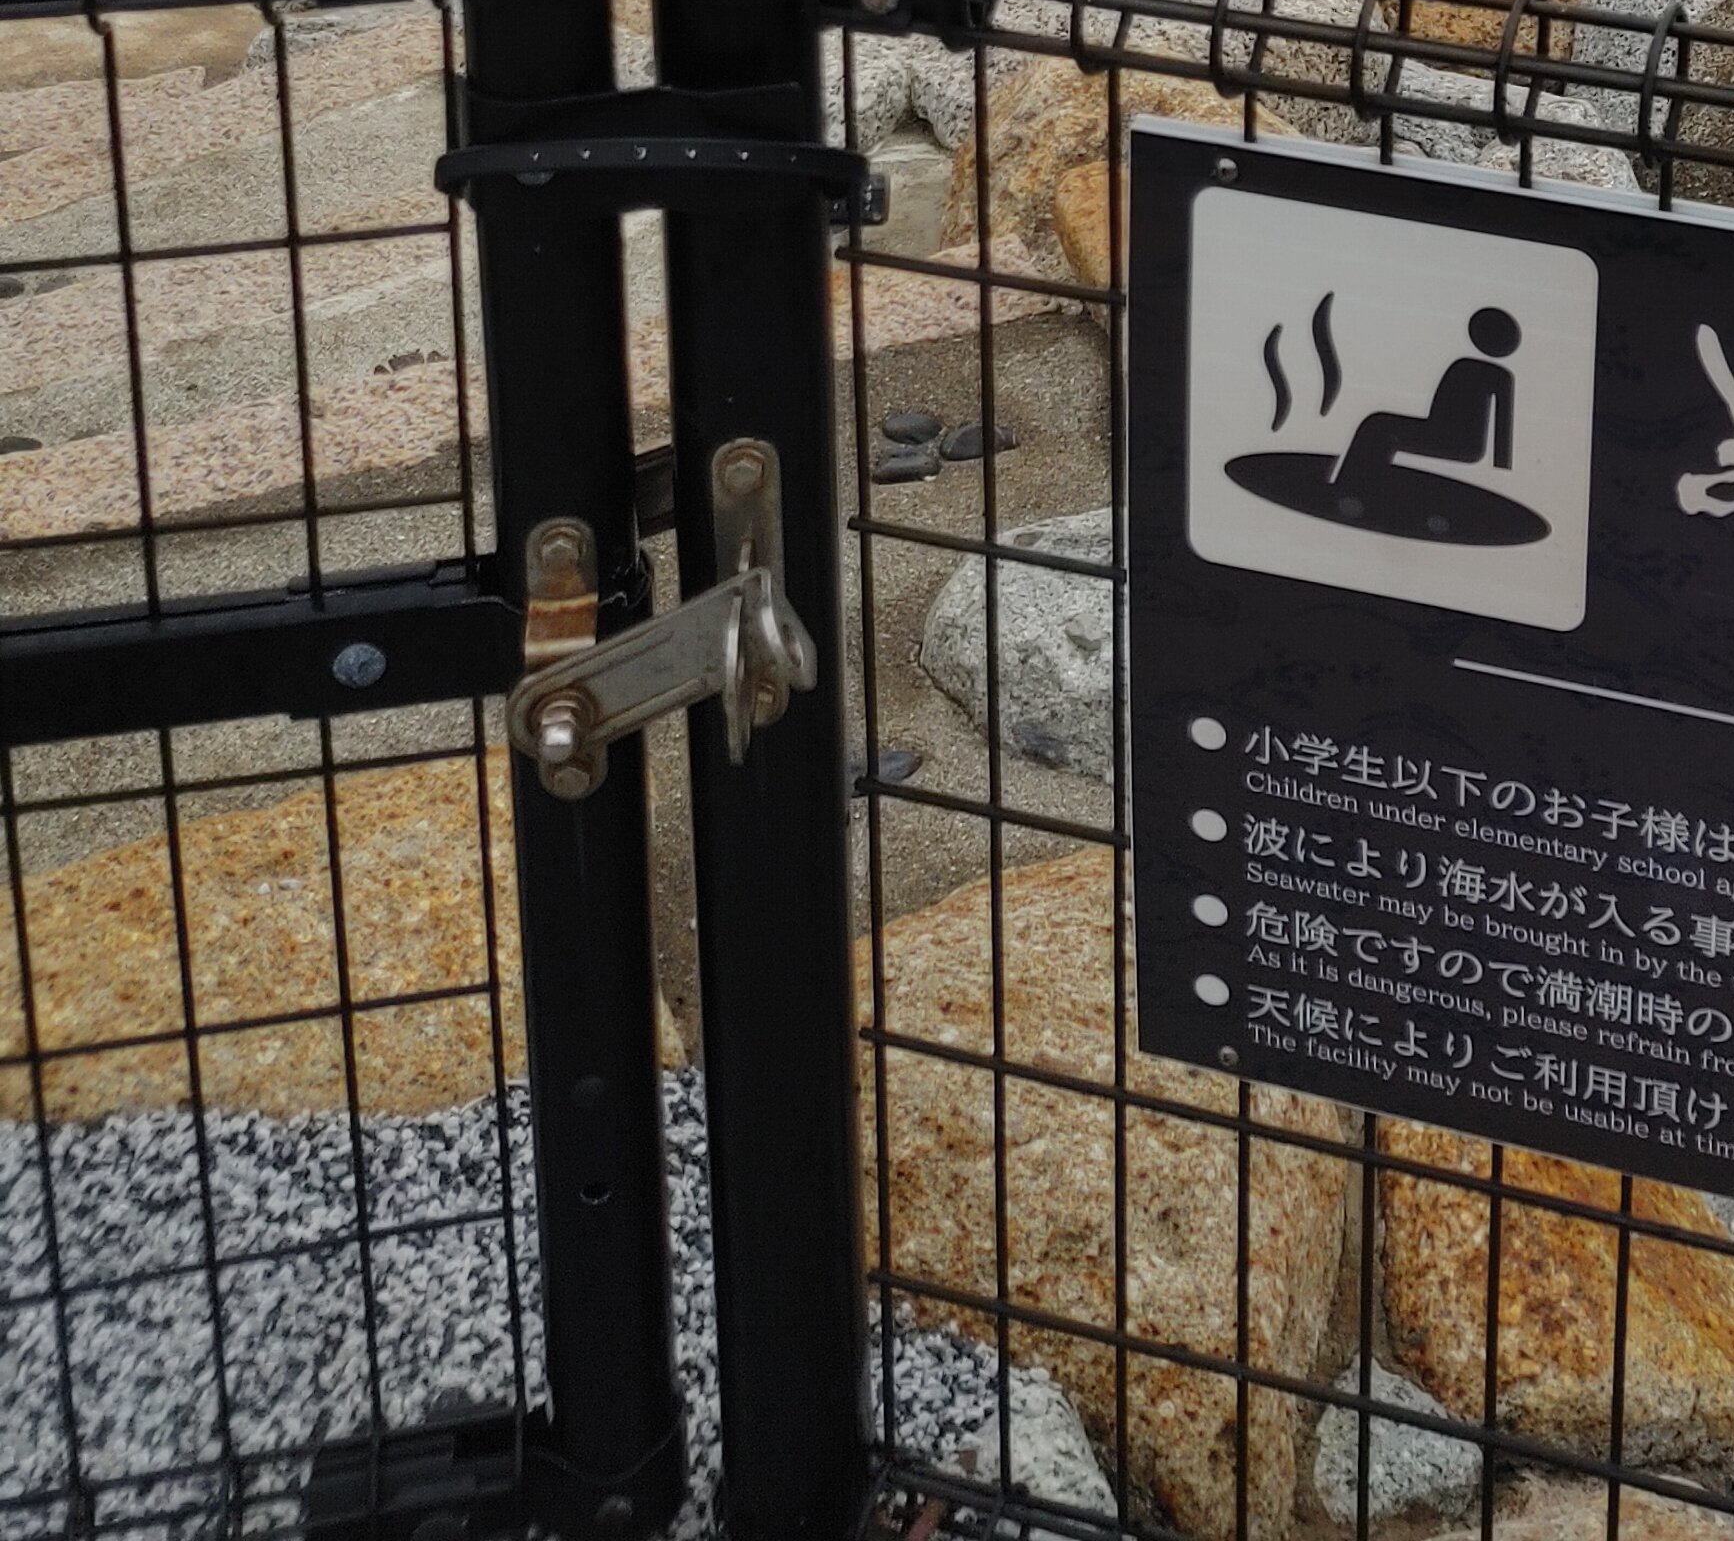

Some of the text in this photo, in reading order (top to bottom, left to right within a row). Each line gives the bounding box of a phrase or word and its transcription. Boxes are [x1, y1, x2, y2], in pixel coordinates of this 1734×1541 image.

[1246, 770, 1359, 814] Children
[1369, 800, 1447, 831] under
[1454, 817, 1608, 872] elementary
[1618, 855, 1706, 890] school
[1246, 861, 1370, 907] Seawater
[1377, 894, 1434, 925] may
[1443, 904, 1475, 931] be
[1485, 913, 1590, 958] brought
[1600, 939, 1624, 966] in
[1635, 947, 1668, 979] by
[1676, 960, 1722, 988] the
[1247, 943, 1281, 969] As
[1291, 951, 1308, 975] it
[1318, 957, 1339, 982] is
[1348, 967, 1492, 1021] dangerous,
[1502, 1005, 1588, 1041] please
[1598, 1028, 1691, 1066] refrain
[1247, 1021, 1296, 1052] The
[1305, 1036, 1397, 1081] facility
[1407, 1065, 1461, 1096] may
[1471, 1080, 1512, 1106] not
[1523, 1088, 1554, 1116] be
[1565, 1103, 1649, 1139] usable
[1659, 1127, 1685, 1149] at
